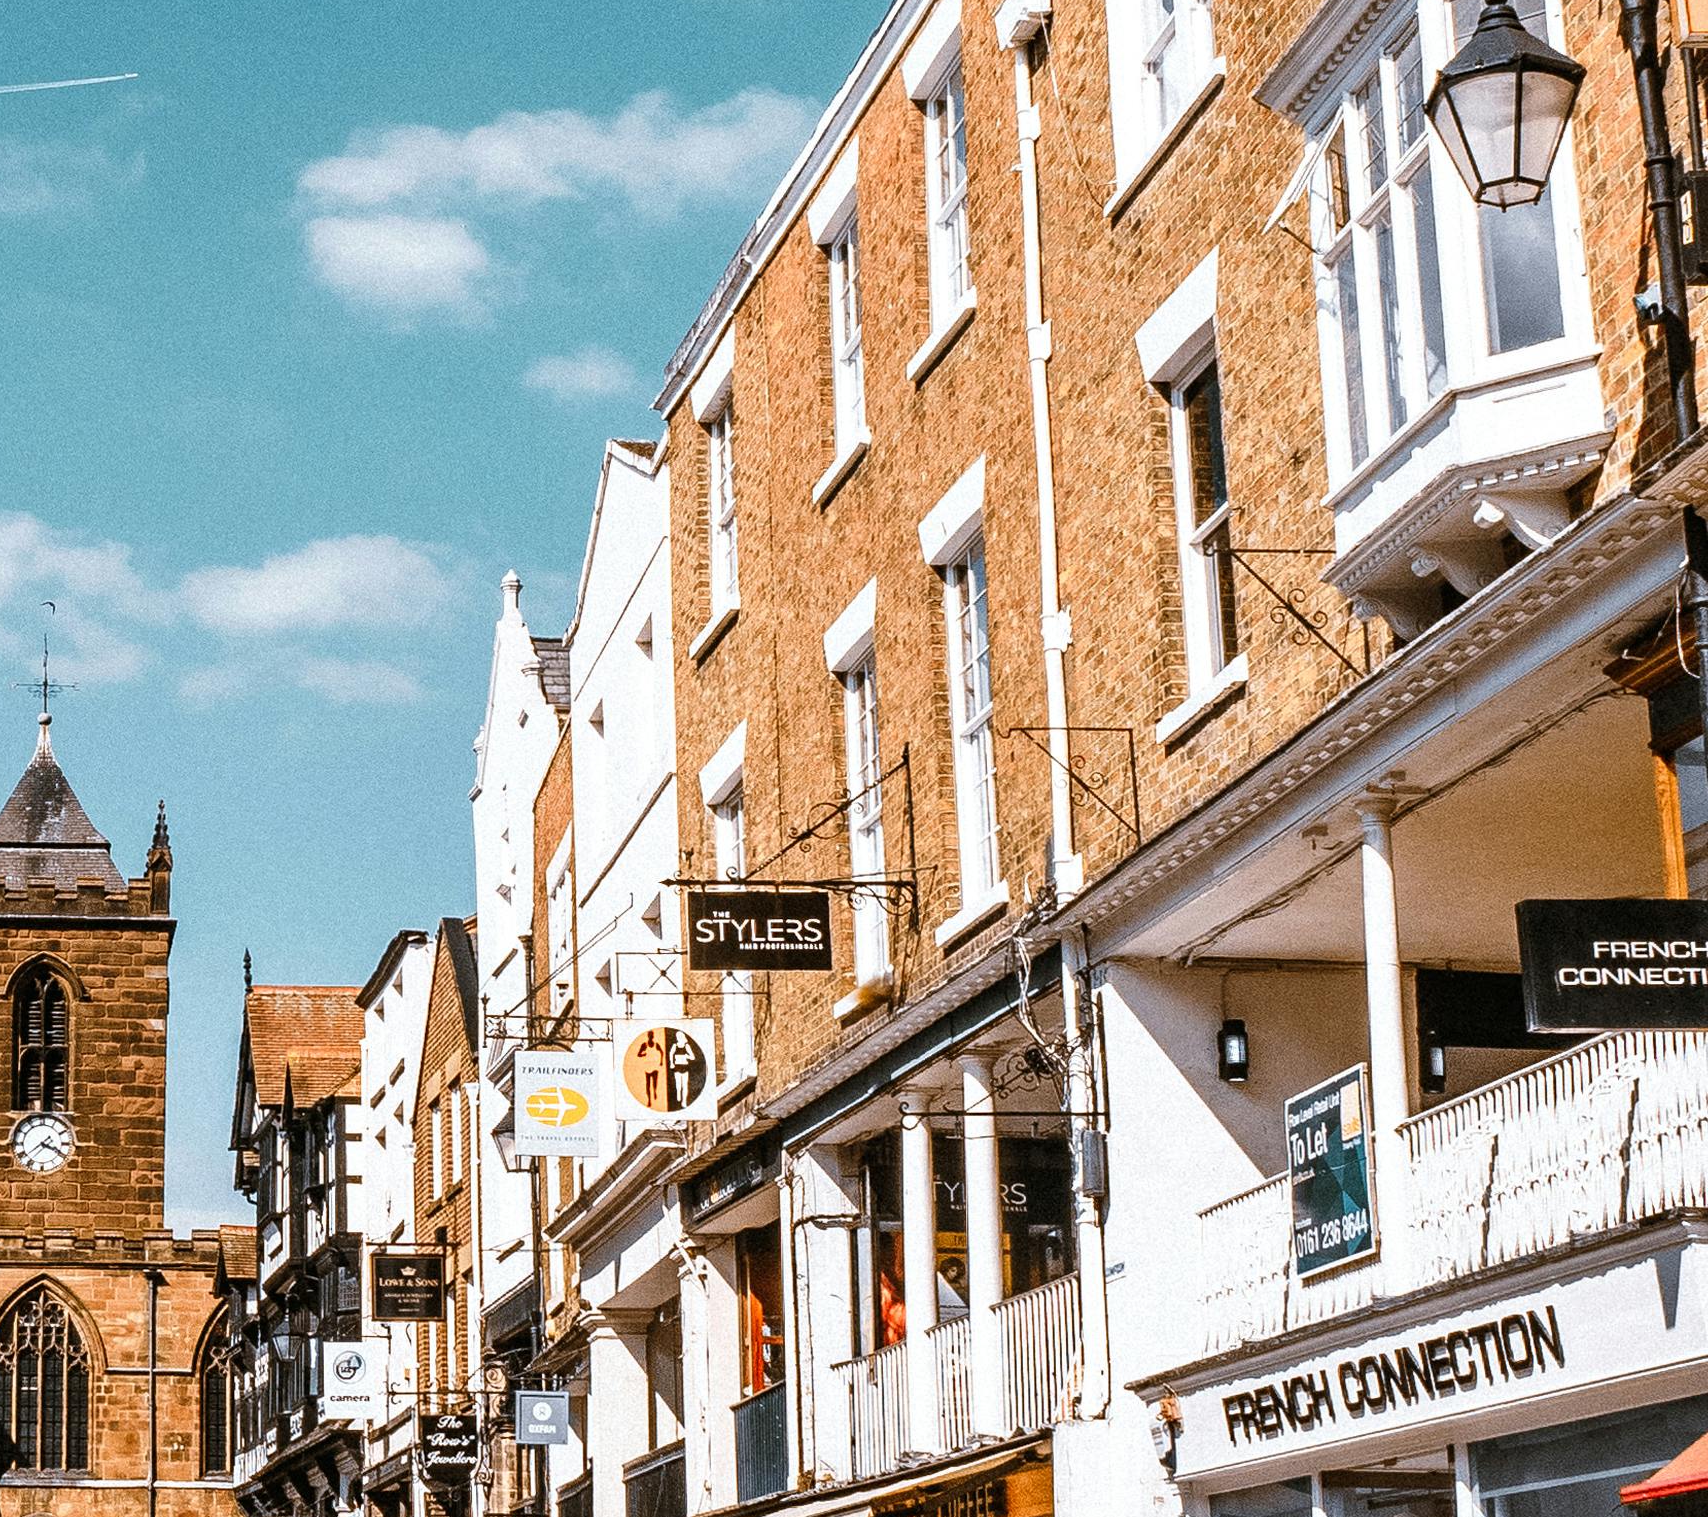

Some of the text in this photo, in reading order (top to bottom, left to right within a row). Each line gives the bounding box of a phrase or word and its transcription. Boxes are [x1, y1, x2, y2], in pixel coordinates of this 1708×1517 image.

[696, 918, 823, 943] STYLERS
[1593, 941, 1708, 959] FRENCH
[522, 1066, 594, 1076] TRAILFINDERS
[1290, 1122, 1329, 1167] To Let
[1297, 1227, 1320, 1258] 0161
[1321, 1220, 1340, 1250] 236
[1342, 1208, 1369, 1242] 8644
[379, 1277, 439, 1287] LOWE & SONS
[1221, 1304, 1567, 1448] FRENCH CONNECTION
[437, 1415, 463, 1429] The
[528, 1424, 557, 1434] OXFAM
[424, 1451, 478, 1466] Jewellers
